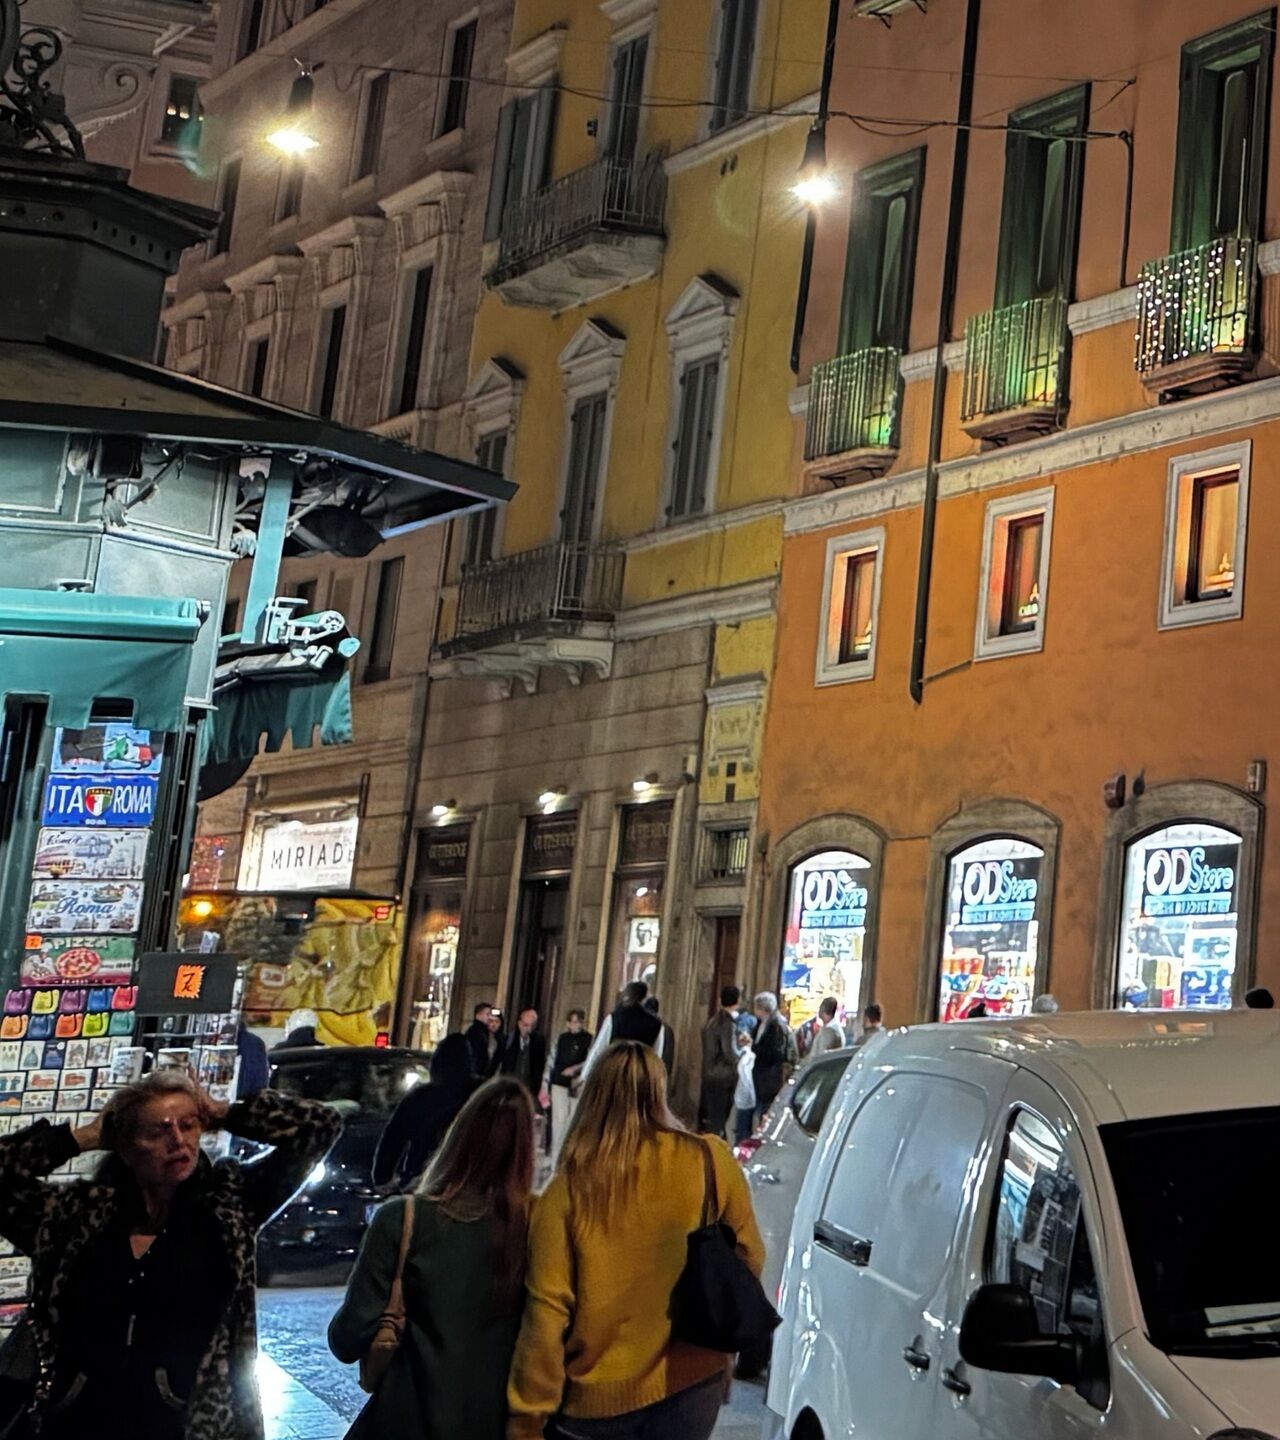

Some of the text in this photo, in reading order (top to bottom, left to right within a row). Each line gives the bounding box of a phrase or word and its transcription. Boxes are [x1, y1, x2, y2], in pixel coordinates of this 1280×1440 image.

[48, 785, 84, 814] ITA
[112, 785, 151, 814] ROMA
[54, 895, 116, 915] Roma
[53, 935, 109, 950] PIZZA
